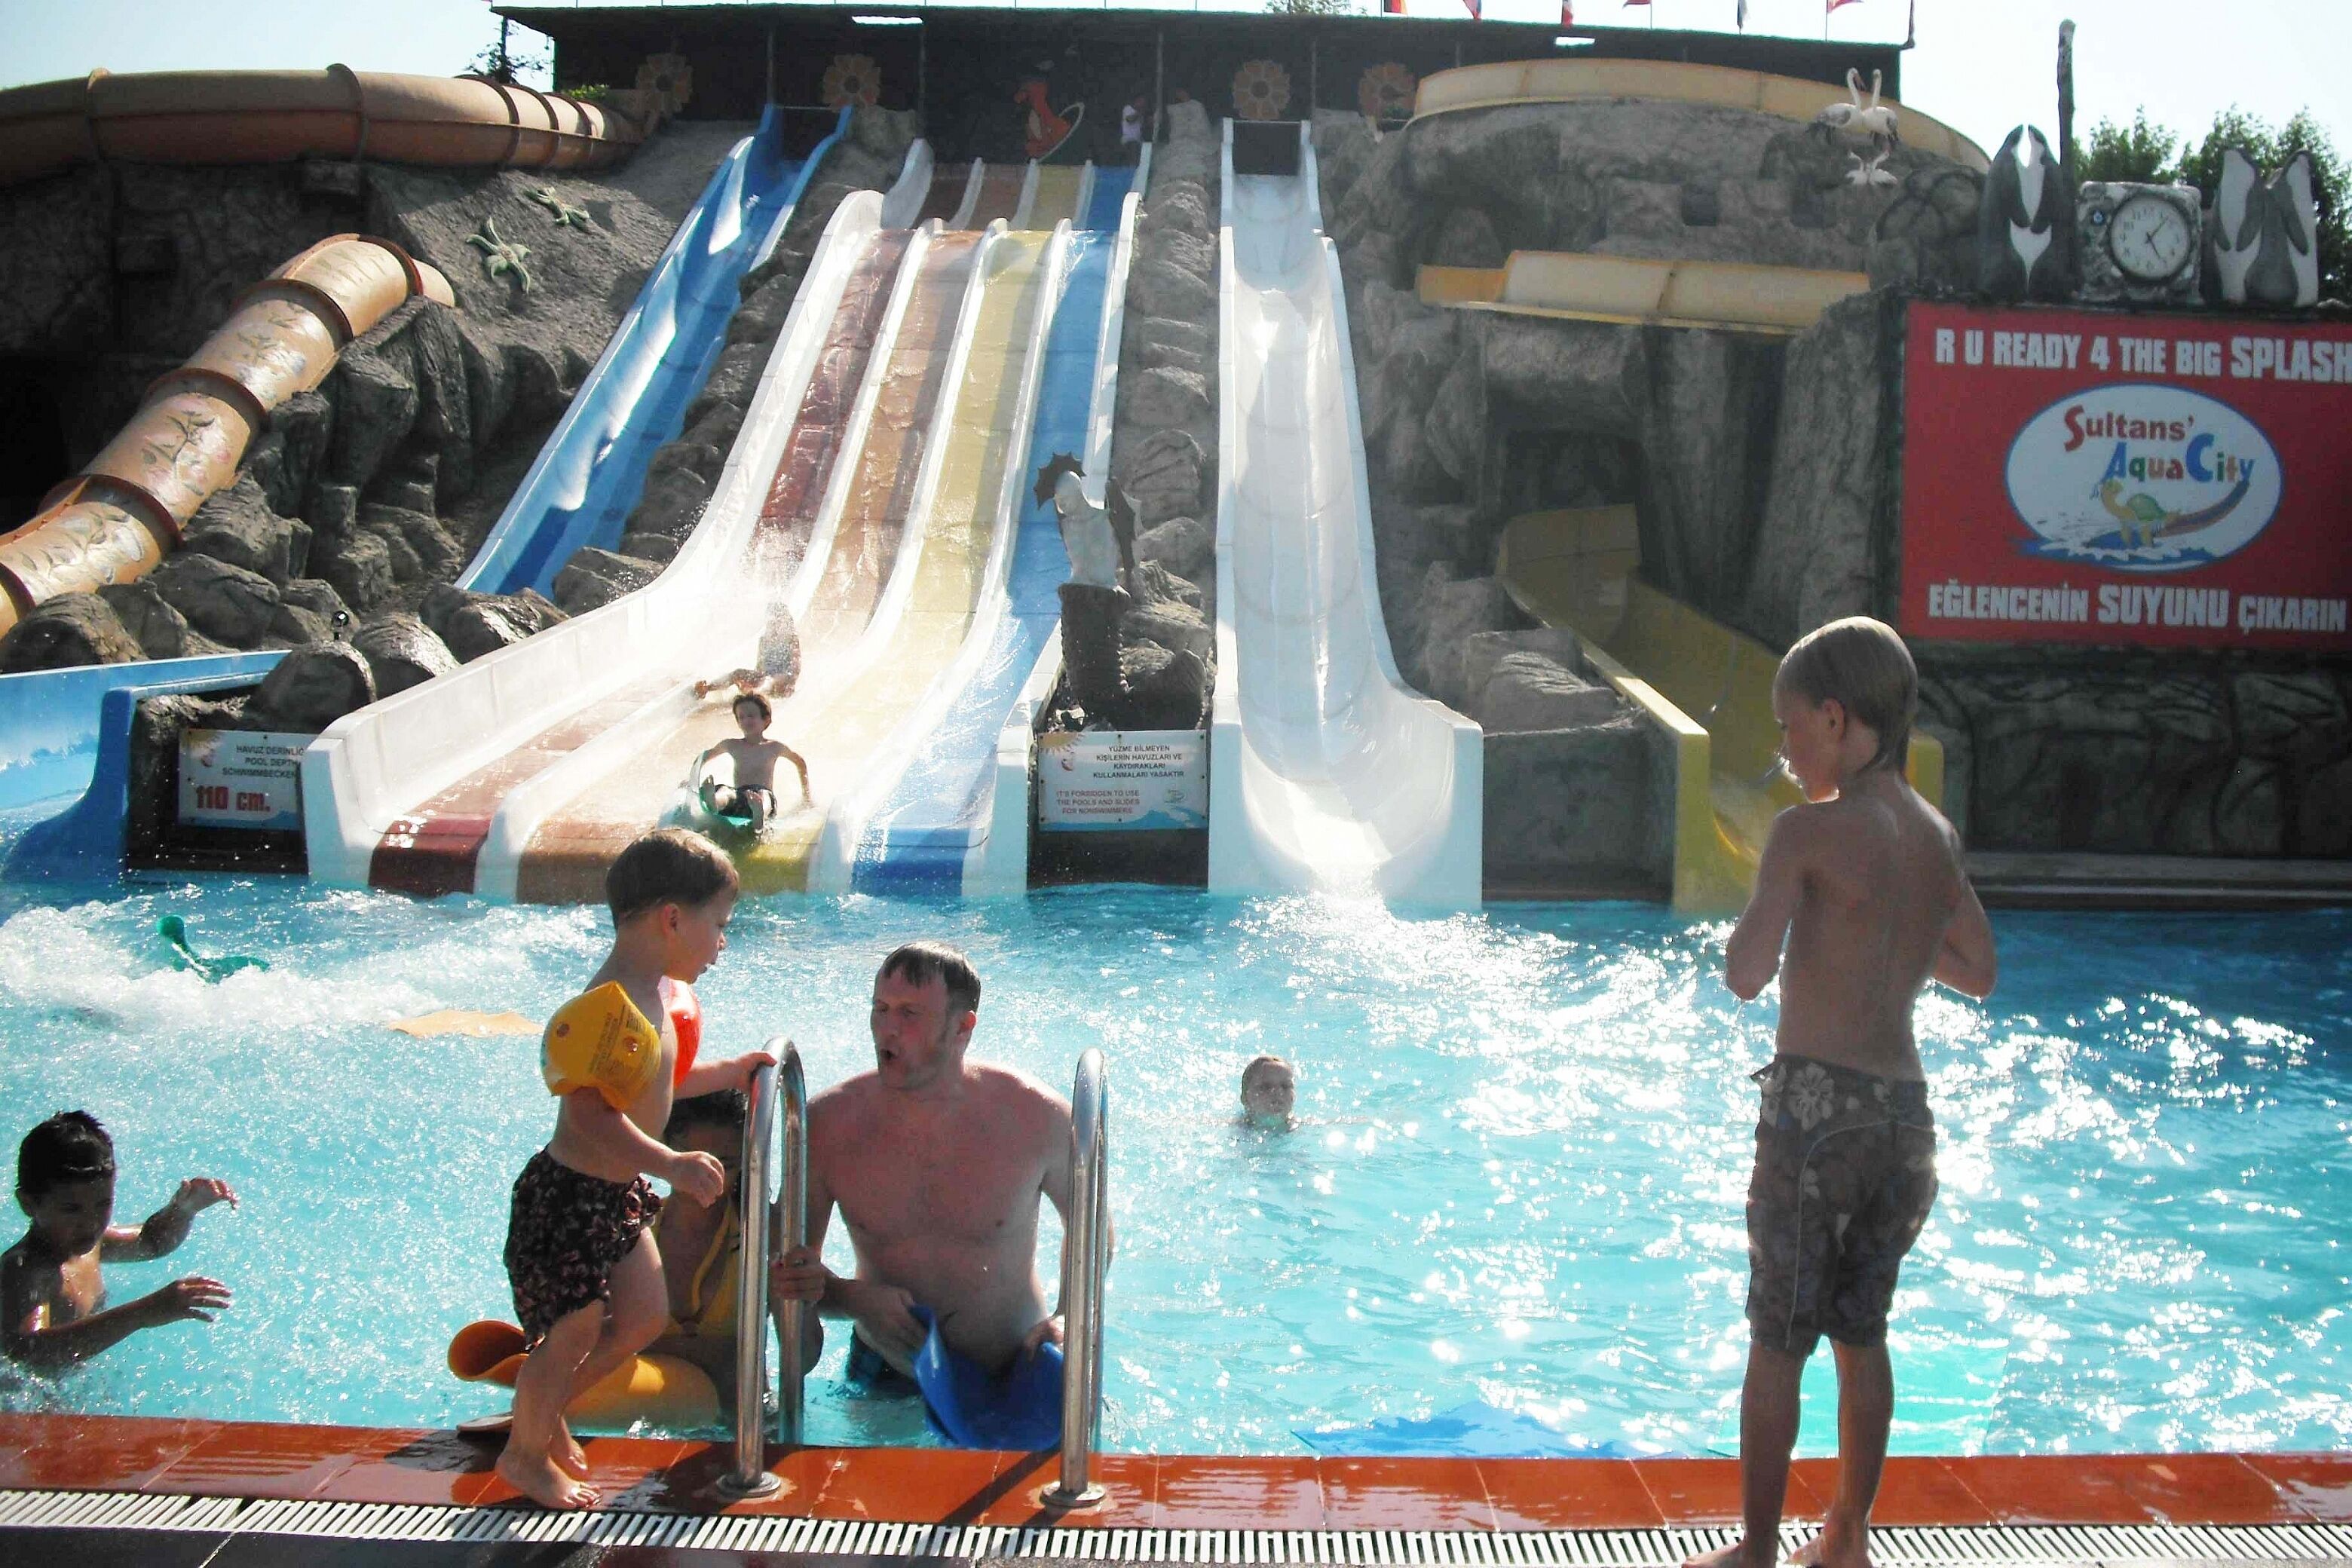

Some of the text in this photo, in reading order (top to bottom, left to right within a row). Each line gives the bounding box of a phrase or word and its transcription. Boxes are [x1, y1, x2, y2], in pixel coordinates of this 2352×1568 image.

[1935, 329, 2352, 383] R U READY 4 THE BIG SPLASH
[1929, 578, 2347, 636] EĞLENCENİN SUYUNU ÇIKARIN
[1134, 743, 1170, 752] BİLMEYEN
[196, 786, 229, 810] 110
